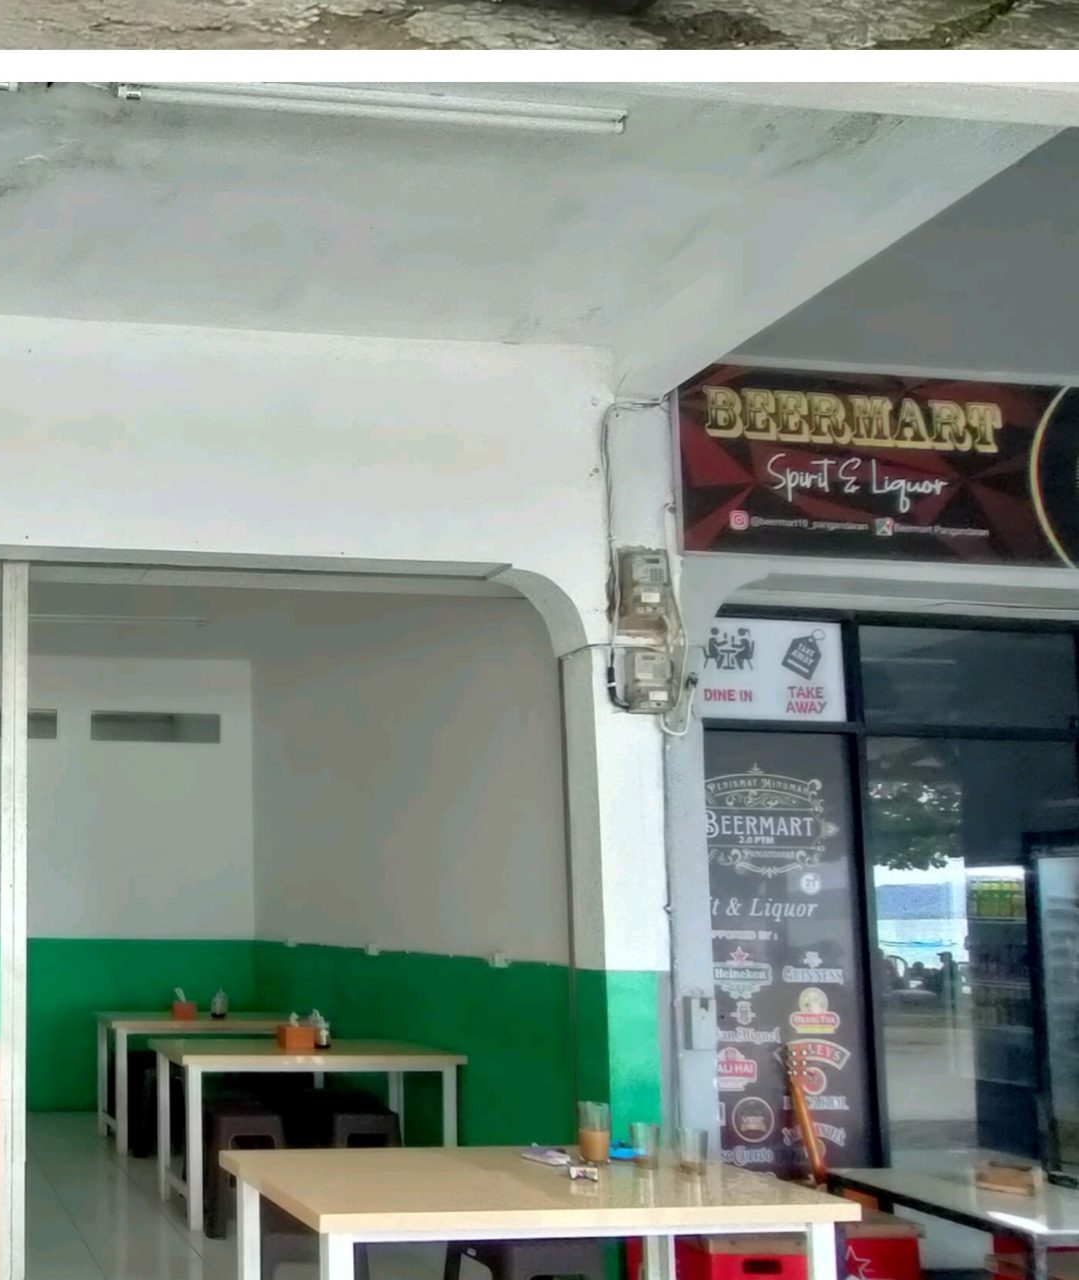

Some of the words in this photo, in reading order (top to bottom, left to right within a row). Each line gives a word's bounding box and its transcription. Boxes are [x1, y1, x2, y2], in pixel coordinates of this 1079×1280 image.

[703, 386, 1003, 454] BEERMART
[767, 453, 836, 502] Spirit
[839, 457, 861, 494] &
[871, 458, 949, 514] Liquor
[704, 688, 736, 702] DINE
[739, 689, 753, 702] IN
[787, 686, 824, 699] TAKE
[785, 701, 827, 714] AWAY
[705, 809, 814, 838] BEERMART
[725, 896, 742, 916] &
[749, 897, 819, 922] Liquor
[714, 967, 767, 980] Heineken
[734, 1063, 754, 1074] HAI
